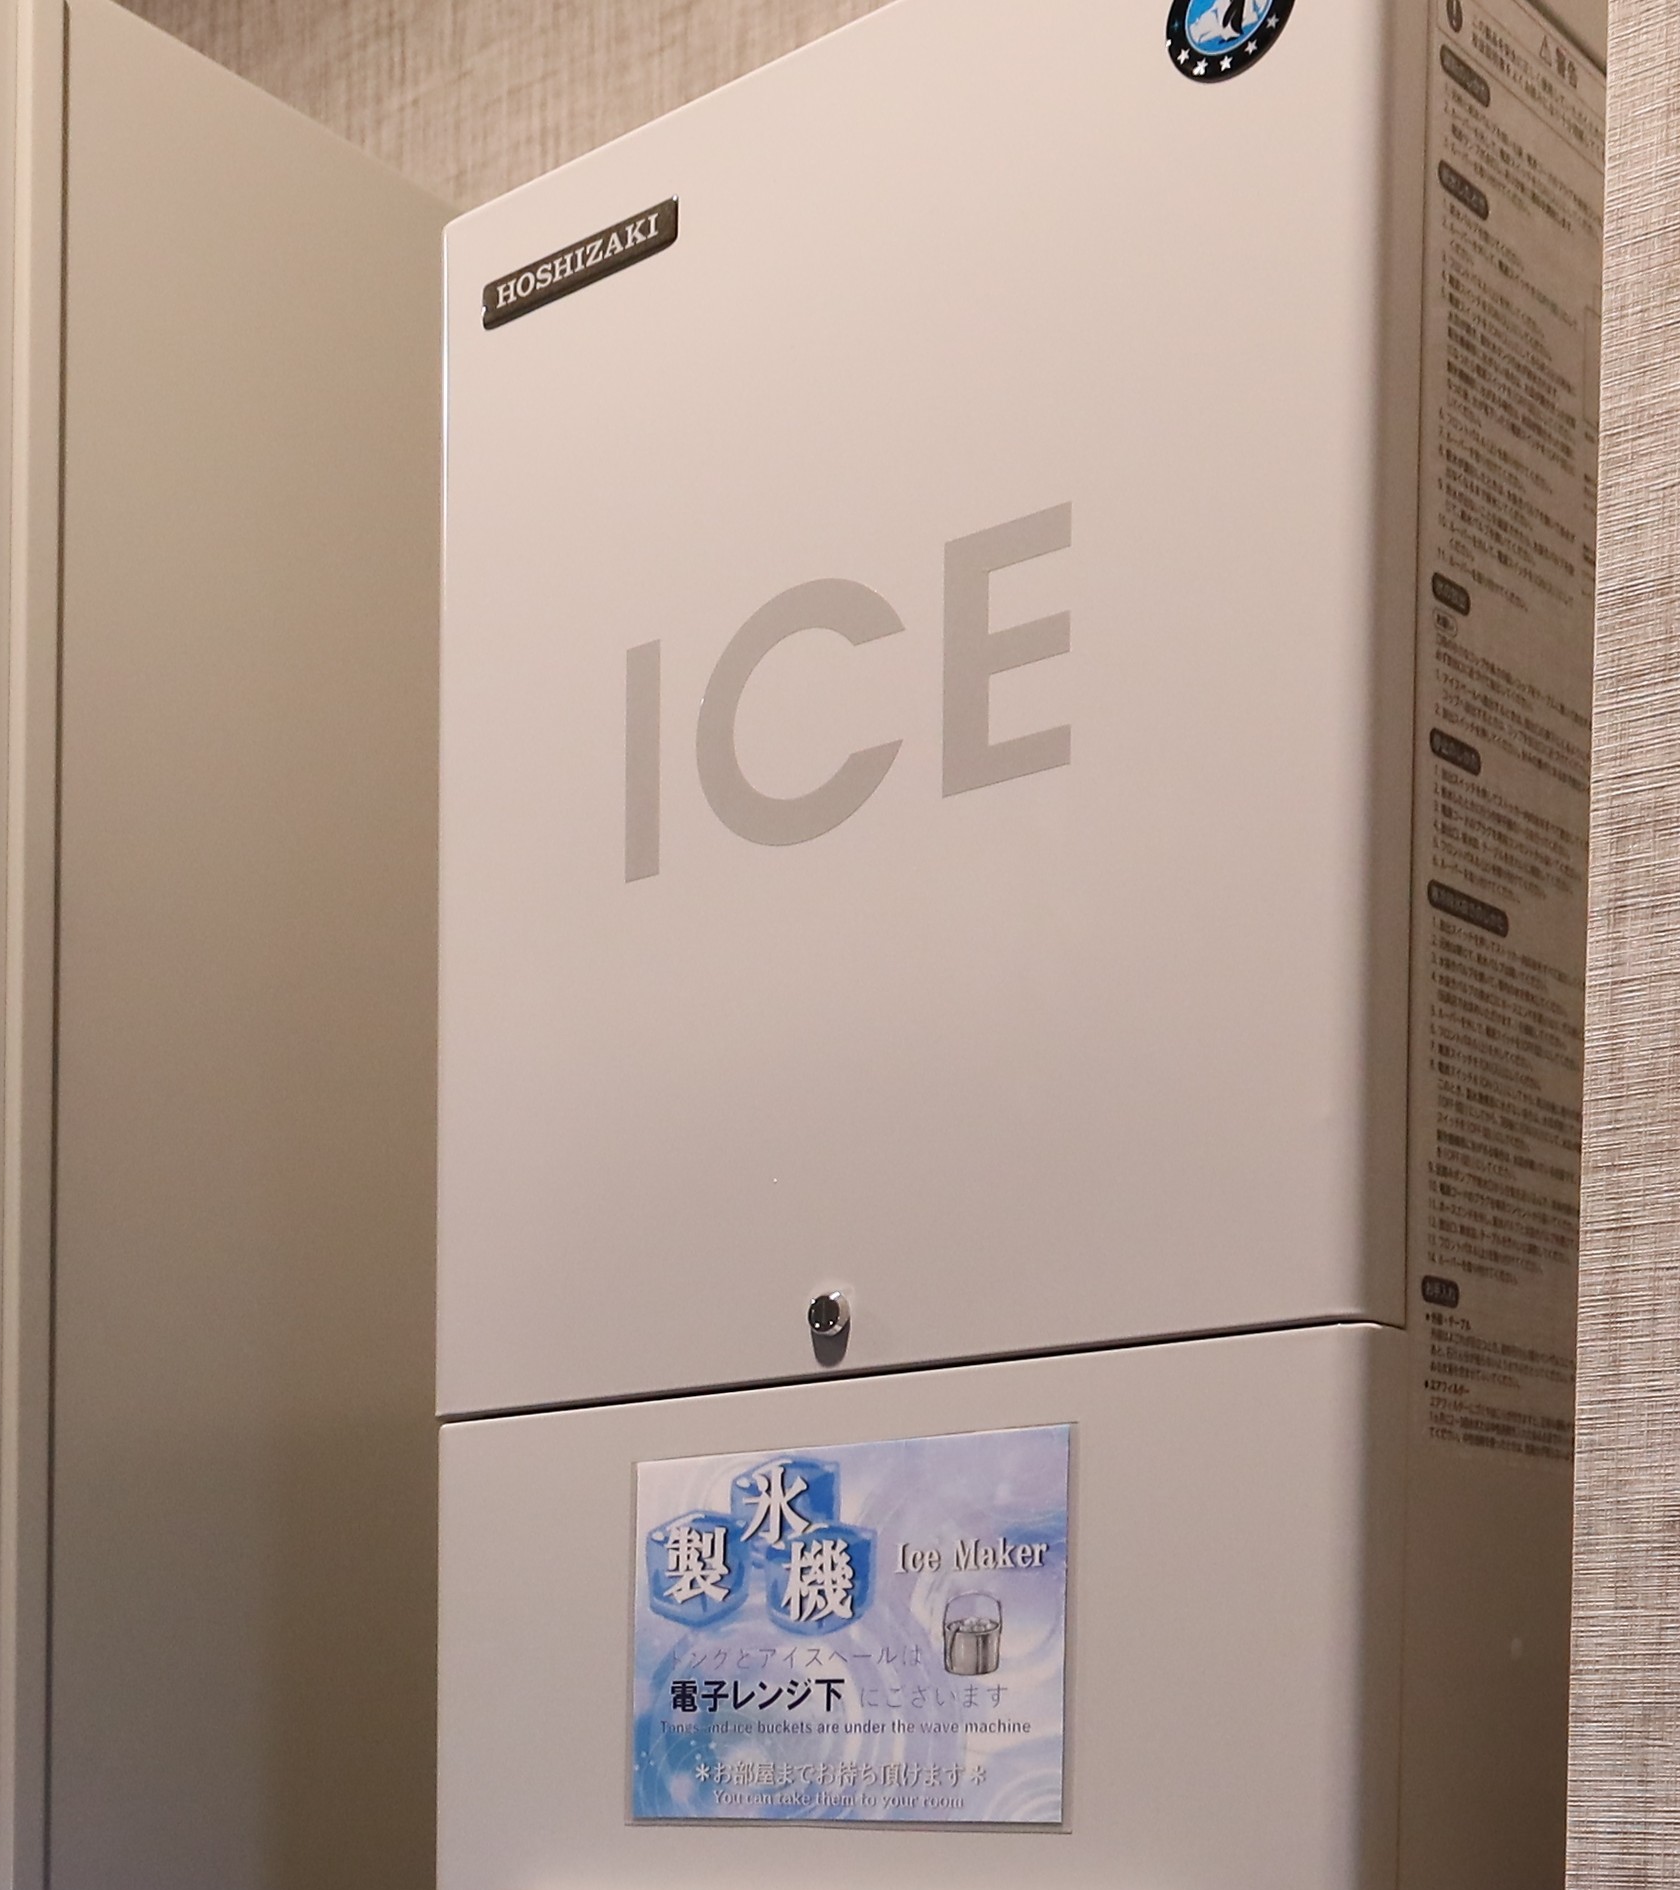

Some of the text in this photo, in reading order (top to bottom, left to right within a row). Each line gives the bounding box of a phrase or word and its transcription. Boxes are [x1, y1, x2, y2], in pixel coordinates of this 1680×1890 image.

[495, 213, 661, 310] HOSHIZAKI
[625, 501, 1072, 884] ICE
[894, 1537, 1050, 1575] Ice Maker
[671, 1678, 845, 1713] 電子レンジ下
[757, 1719, 813, 1734] buckets
[817, 1723, 839, 1734] are
[844, 1719, 886, 1734] under
[891, 1719, 915, 1734] the
[920, 1722, 959, 1734] wave
[964, 1718, 1032, 1734] machine
[713, 1789, 964, 1809] You can take them to your room
